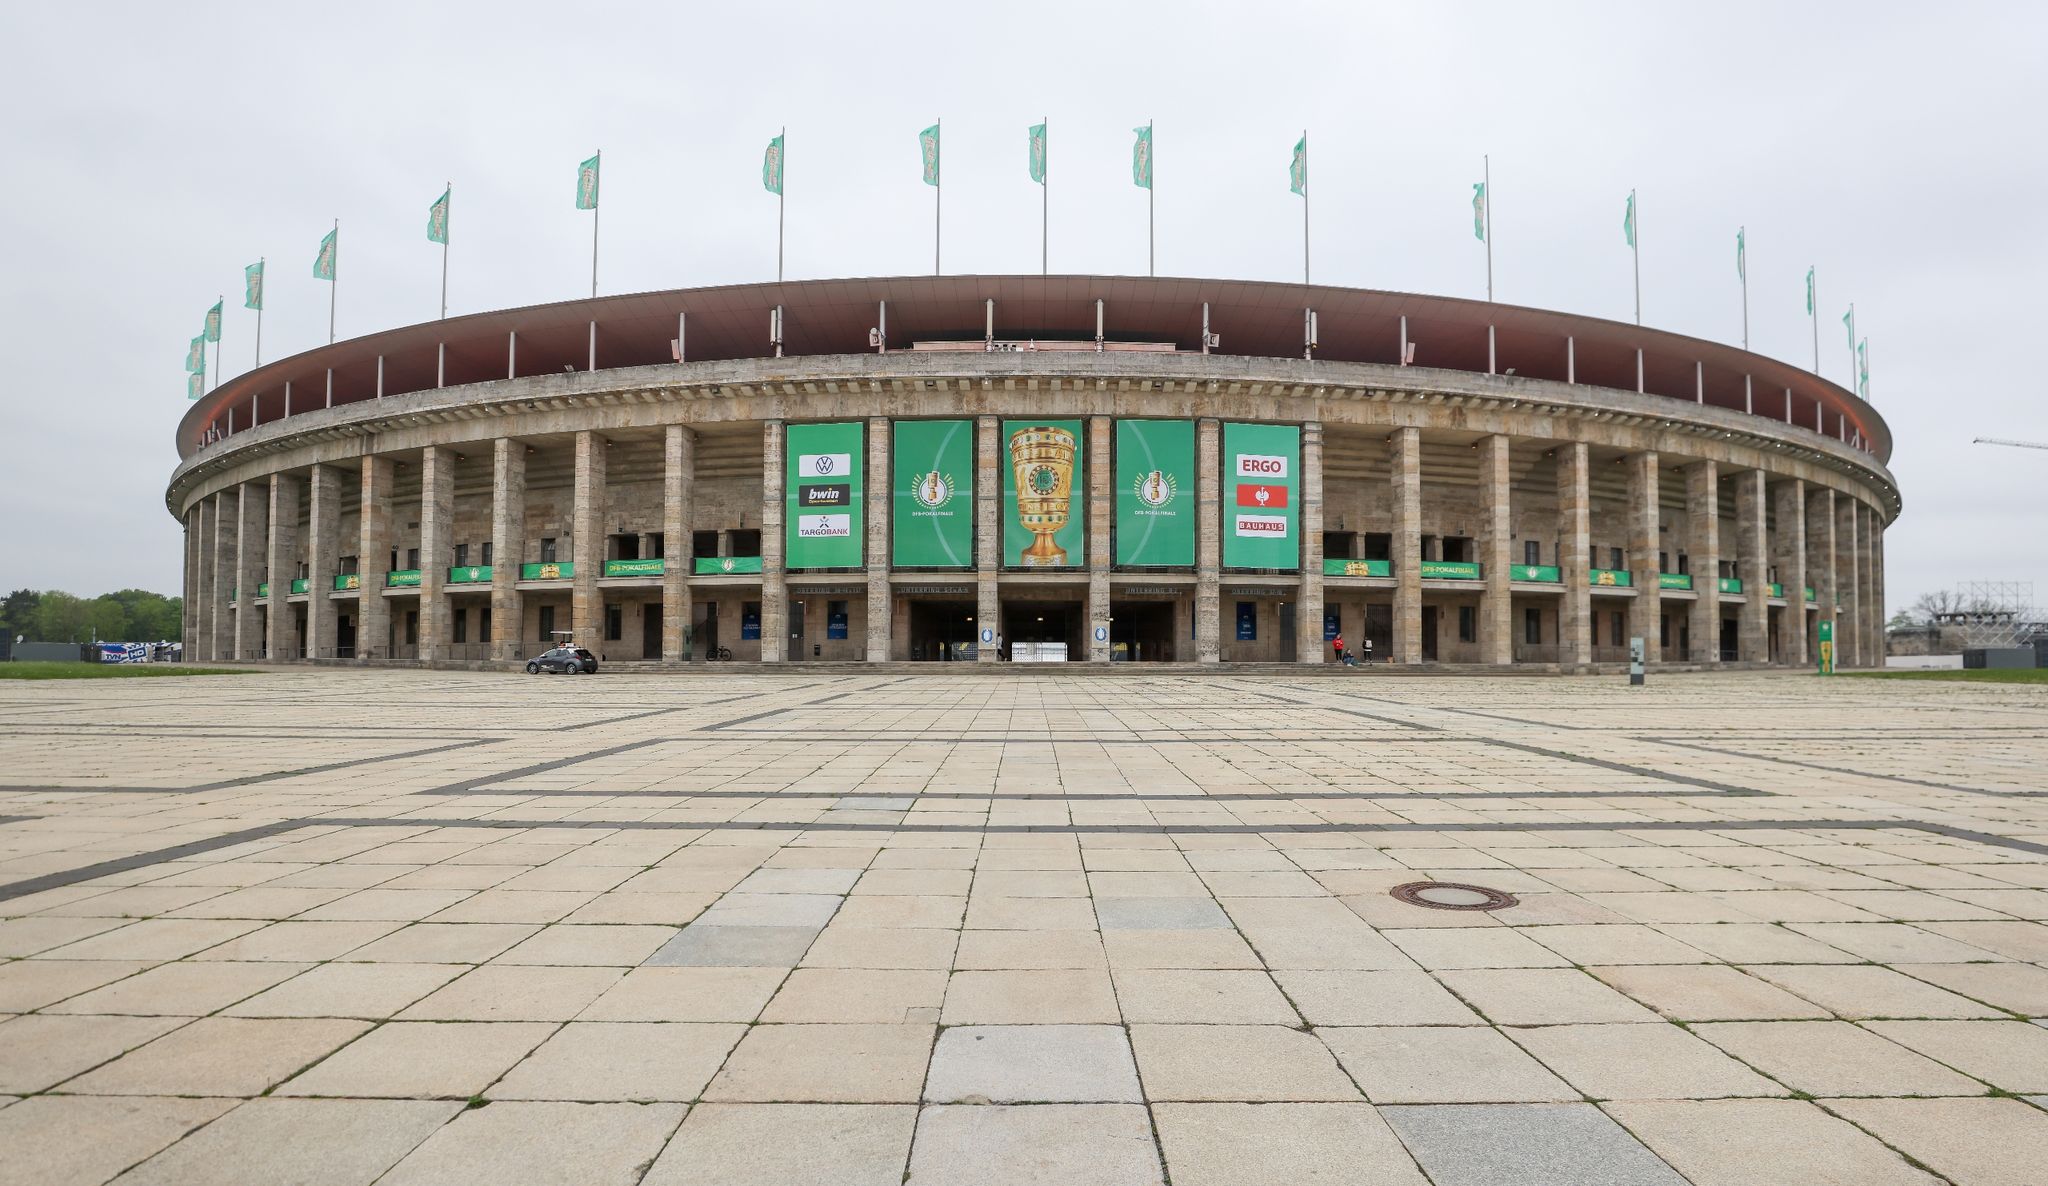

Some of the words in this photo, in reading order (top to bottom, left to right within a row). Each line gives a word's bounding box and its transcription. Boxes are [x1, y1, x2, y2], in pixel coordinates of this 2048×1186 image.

[1242, 459, 1281, 473] ERGO
[809, 488, 839, 499] bwin
[1239, 522, 1284, 531] BAUHAUS
[608, 563, 662, 572] DFB-POKALFINALE
[1423, 566, 1474, 574] DFB-POKALFINALE
[129, 649, 145, 658] HD
